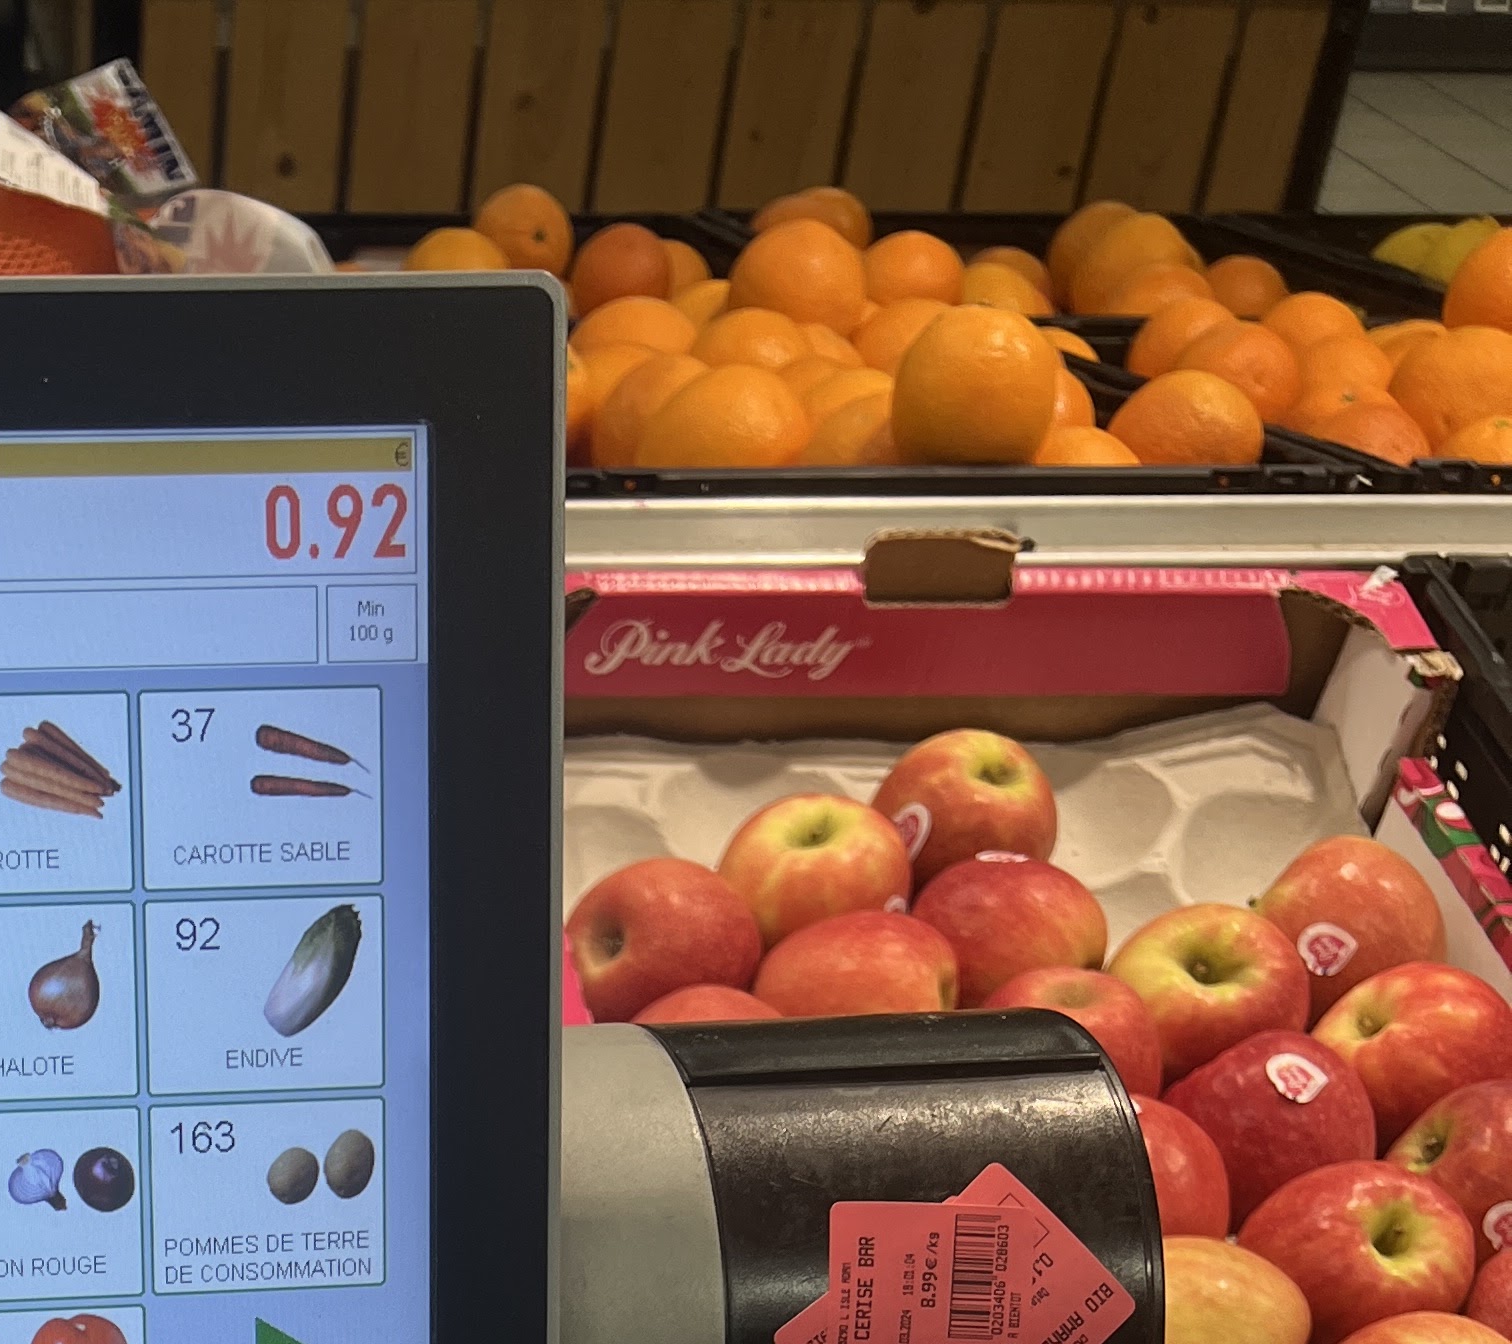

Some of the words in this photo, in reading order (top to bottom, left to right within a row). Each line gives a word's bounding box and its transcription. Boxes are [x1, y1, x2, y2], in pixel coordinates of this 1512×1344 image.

[393, 443, 409, 467] €
[265, 483, 407, 560] 0.92
[357, 601, 385, 617] Min
[348, 624, 378, 642] 100
[383, 626, 394, 645] g
[584, 619, 725, 675] Pink
[720, 621, 854, 681] Lady
[171, 708, 215, 742] 37
[173, 843, 273, 866] CAROTTE
[279, 840, 351, 862] SABLE
[175, 918, 221, 952] 92
[225, 1046, 304, 1069] ENDIVE
[170, 1121, 235, 1155] 163
[164, 1235, 259, 1258] POMMES
[266, 1233, 295, 1254] DE
[301, 1230, 370, 1252] TERRE
[857, 1236, 875, 1266] BAR
[31, 1255, 107, 1277] ROUGE
[165, 1263, 193, 1284] DE
[200, 1256, 372, 1283] CONSOMMATION
[852, 1277, 874, 1339] CERISE
[989, 1280, 1006, 1335] 0203406
[1084, 1282, 1114, 1314] BIO
